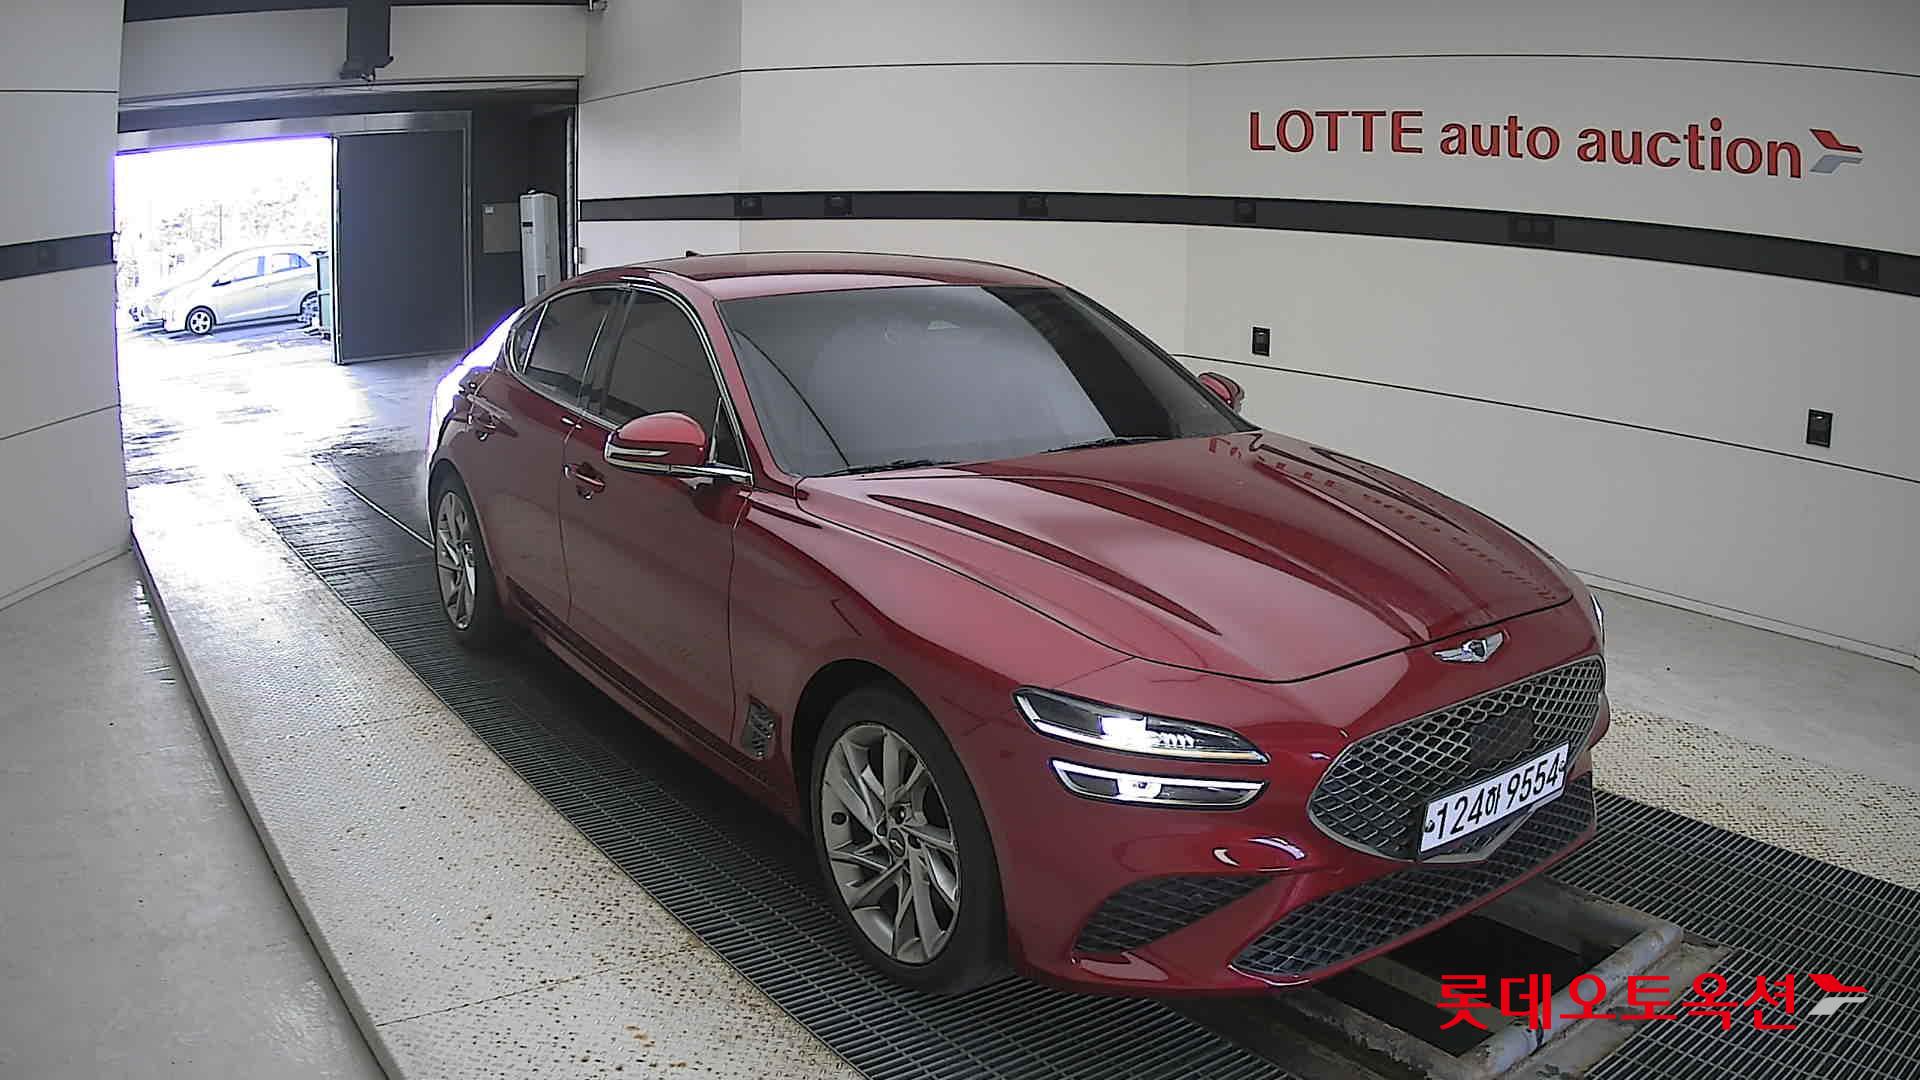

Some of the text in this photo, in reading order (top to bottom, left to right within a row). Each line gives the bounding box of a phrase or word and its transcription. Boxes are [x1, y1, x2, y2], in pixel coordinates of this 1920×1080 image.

[1249, 110, 1802, 178] LOTTE auto auction
[1505, 752, 1561, 810] 9554
